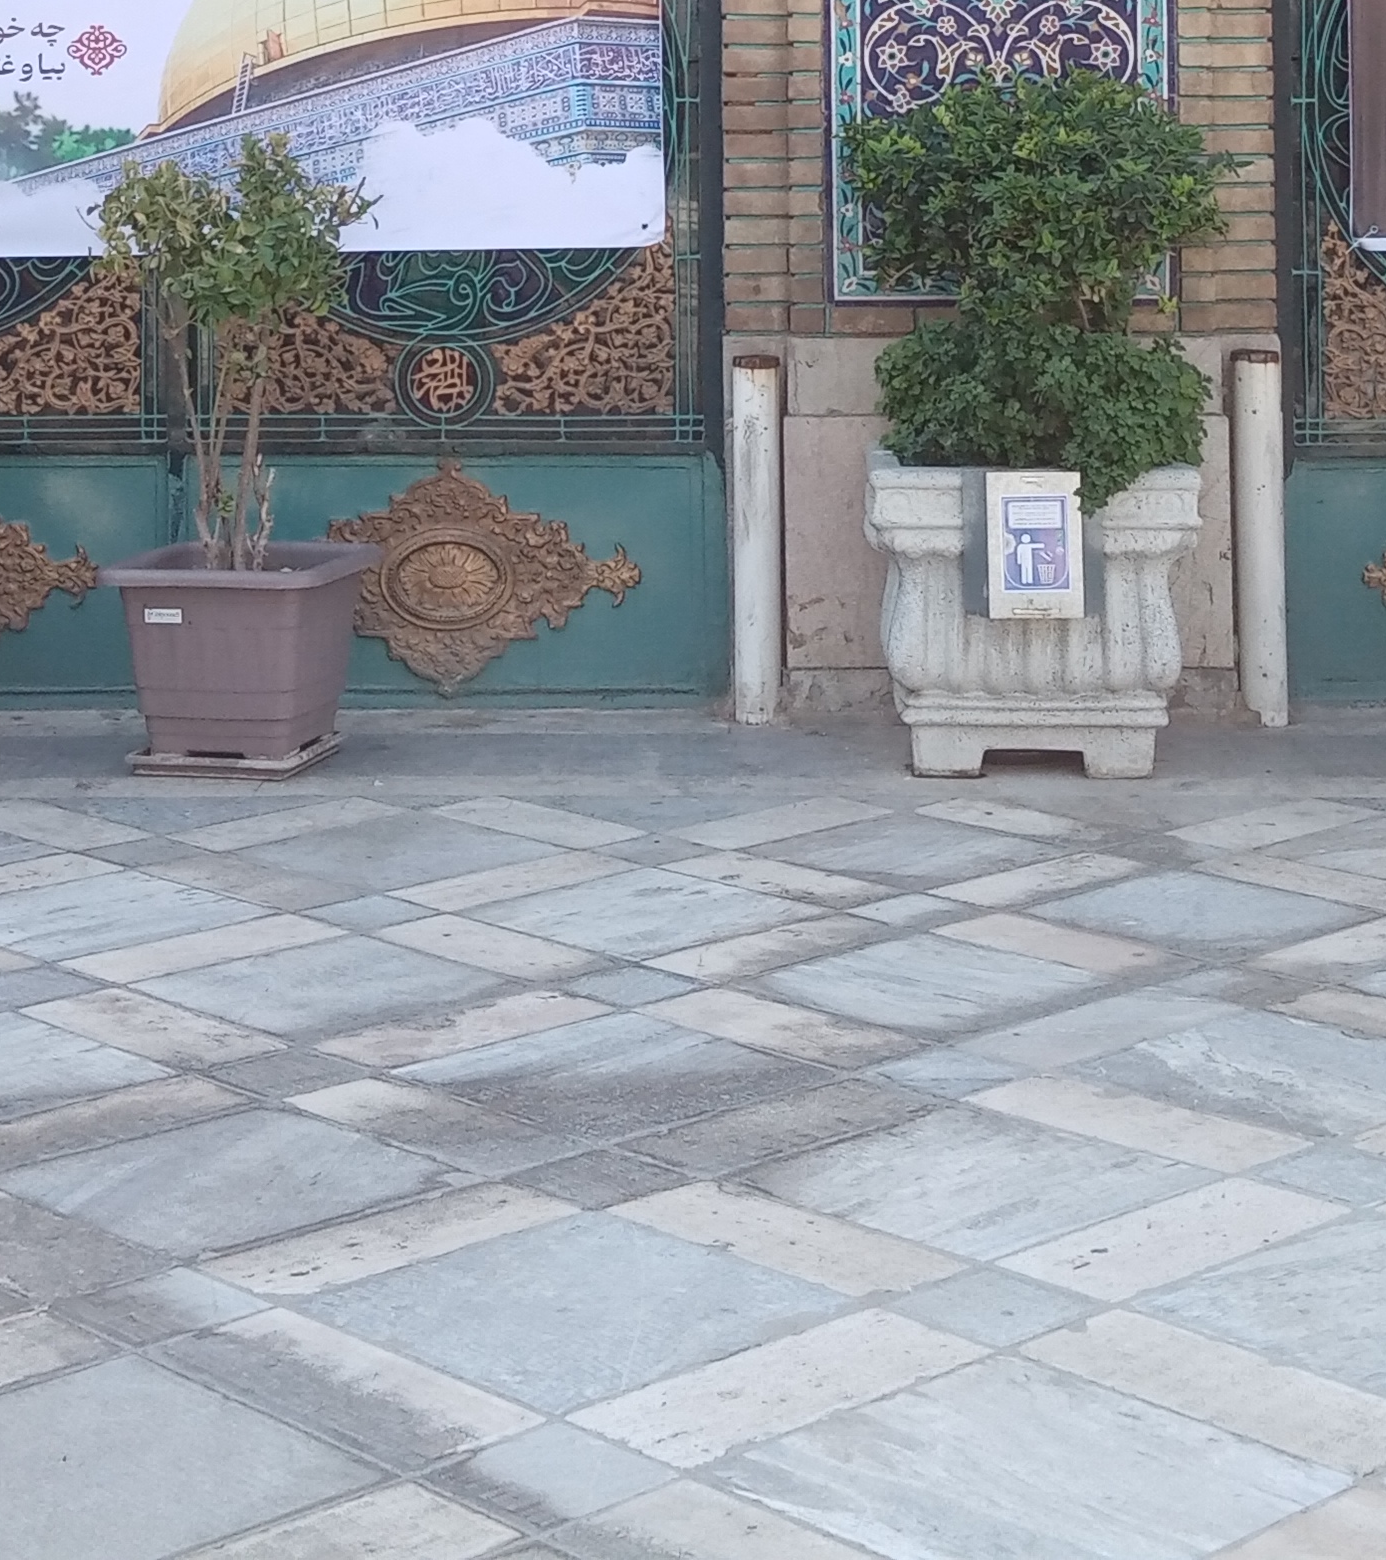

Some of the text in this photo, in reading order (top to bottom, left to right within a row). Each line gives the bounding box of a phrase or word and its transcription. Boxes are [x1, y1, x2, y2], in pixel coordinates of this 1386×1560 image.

[30, 21, 65, 47] چه
[19, 62, 33, 81] و
[38, 53, 66, 81] بیا
